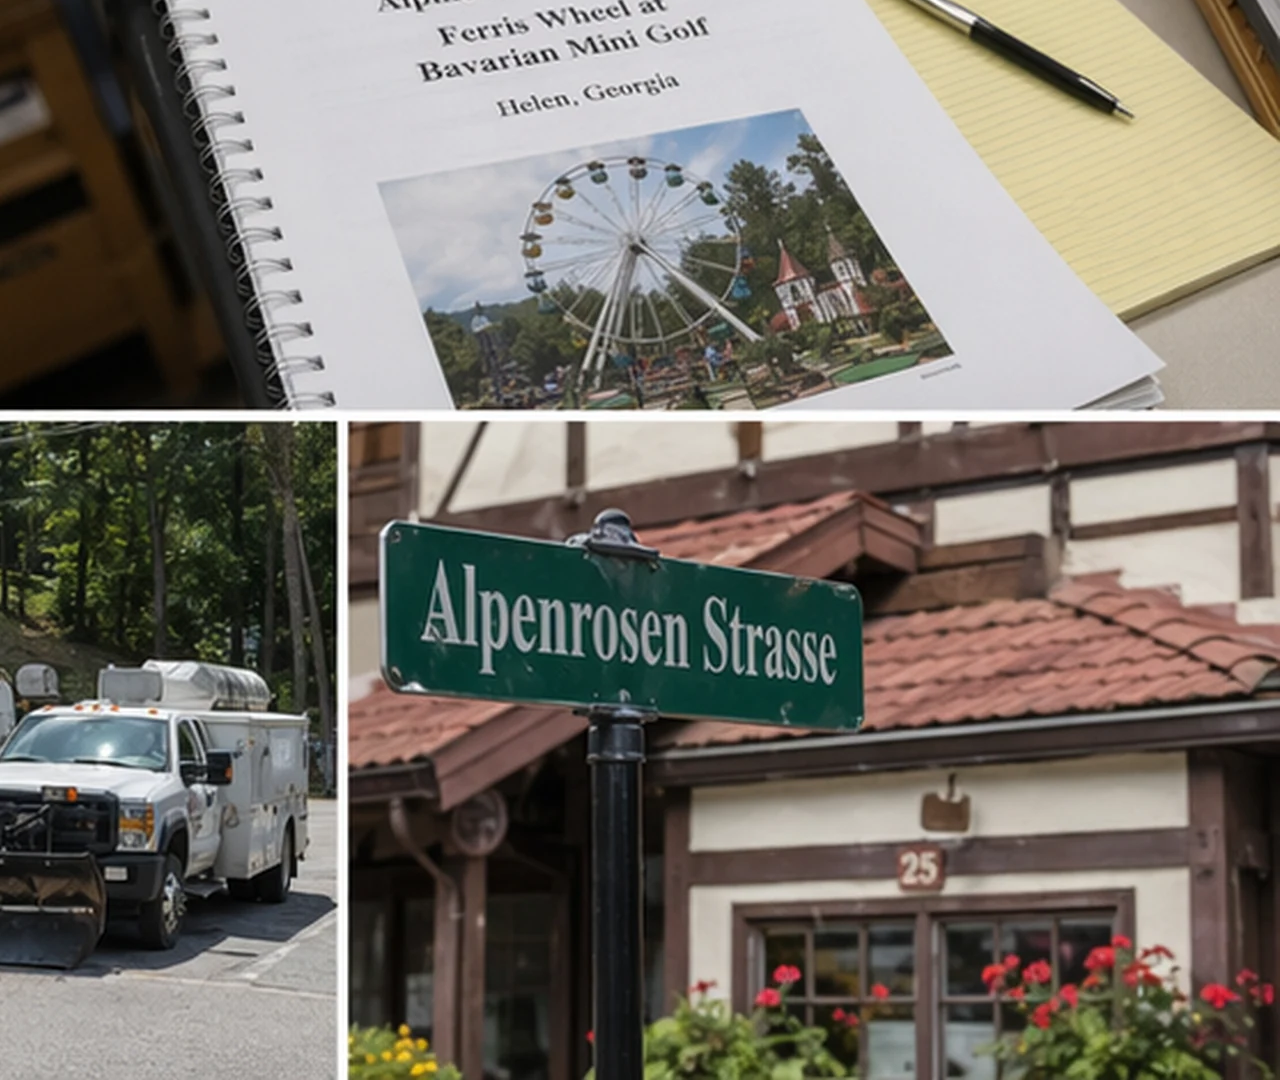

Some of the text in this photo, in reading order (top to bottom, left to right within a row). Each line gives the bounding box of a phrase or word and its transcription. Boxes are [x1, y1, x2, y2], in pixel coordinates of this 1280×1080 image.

[417, 16, 710, 83] Bavarian Mini Golf
[437, 16, 530, 47] Ferris
[496, 72, 680, 117] Helen, Georgia
[420, 559, 837, 685] Alpenrosen Strasse
[900, 851, 938, 885] 25
